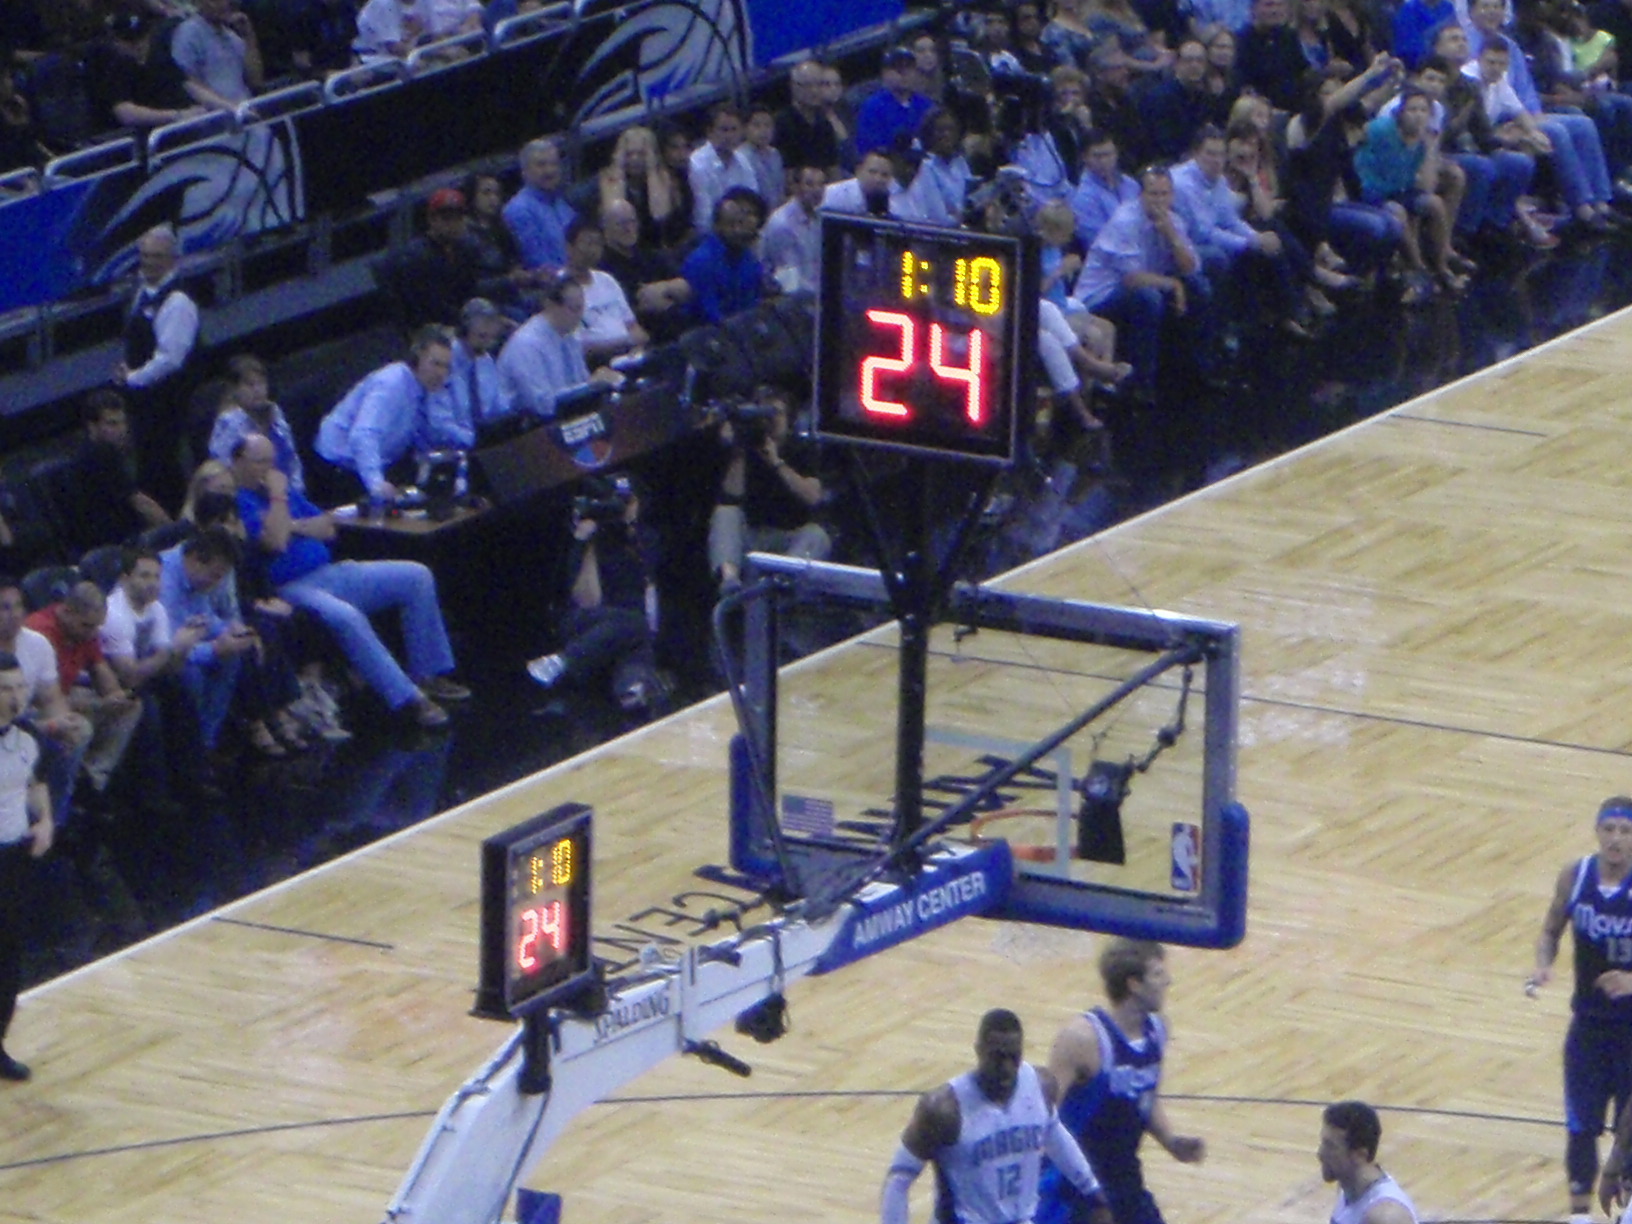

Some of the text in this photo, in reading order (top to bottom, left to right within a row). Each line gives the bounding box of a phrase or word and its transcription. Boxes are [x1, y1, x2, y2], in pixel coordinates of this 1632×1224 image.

[900, 249, 1001, 316] 1:10
[860, 309, 984, 424] 24
[561, 411, 606, 445] ESPN
[519, 900, 561, 969] 24
[853, 870, 987, 950] AMWAY CENTER
[996, 1163, 1021, 1200] 12
